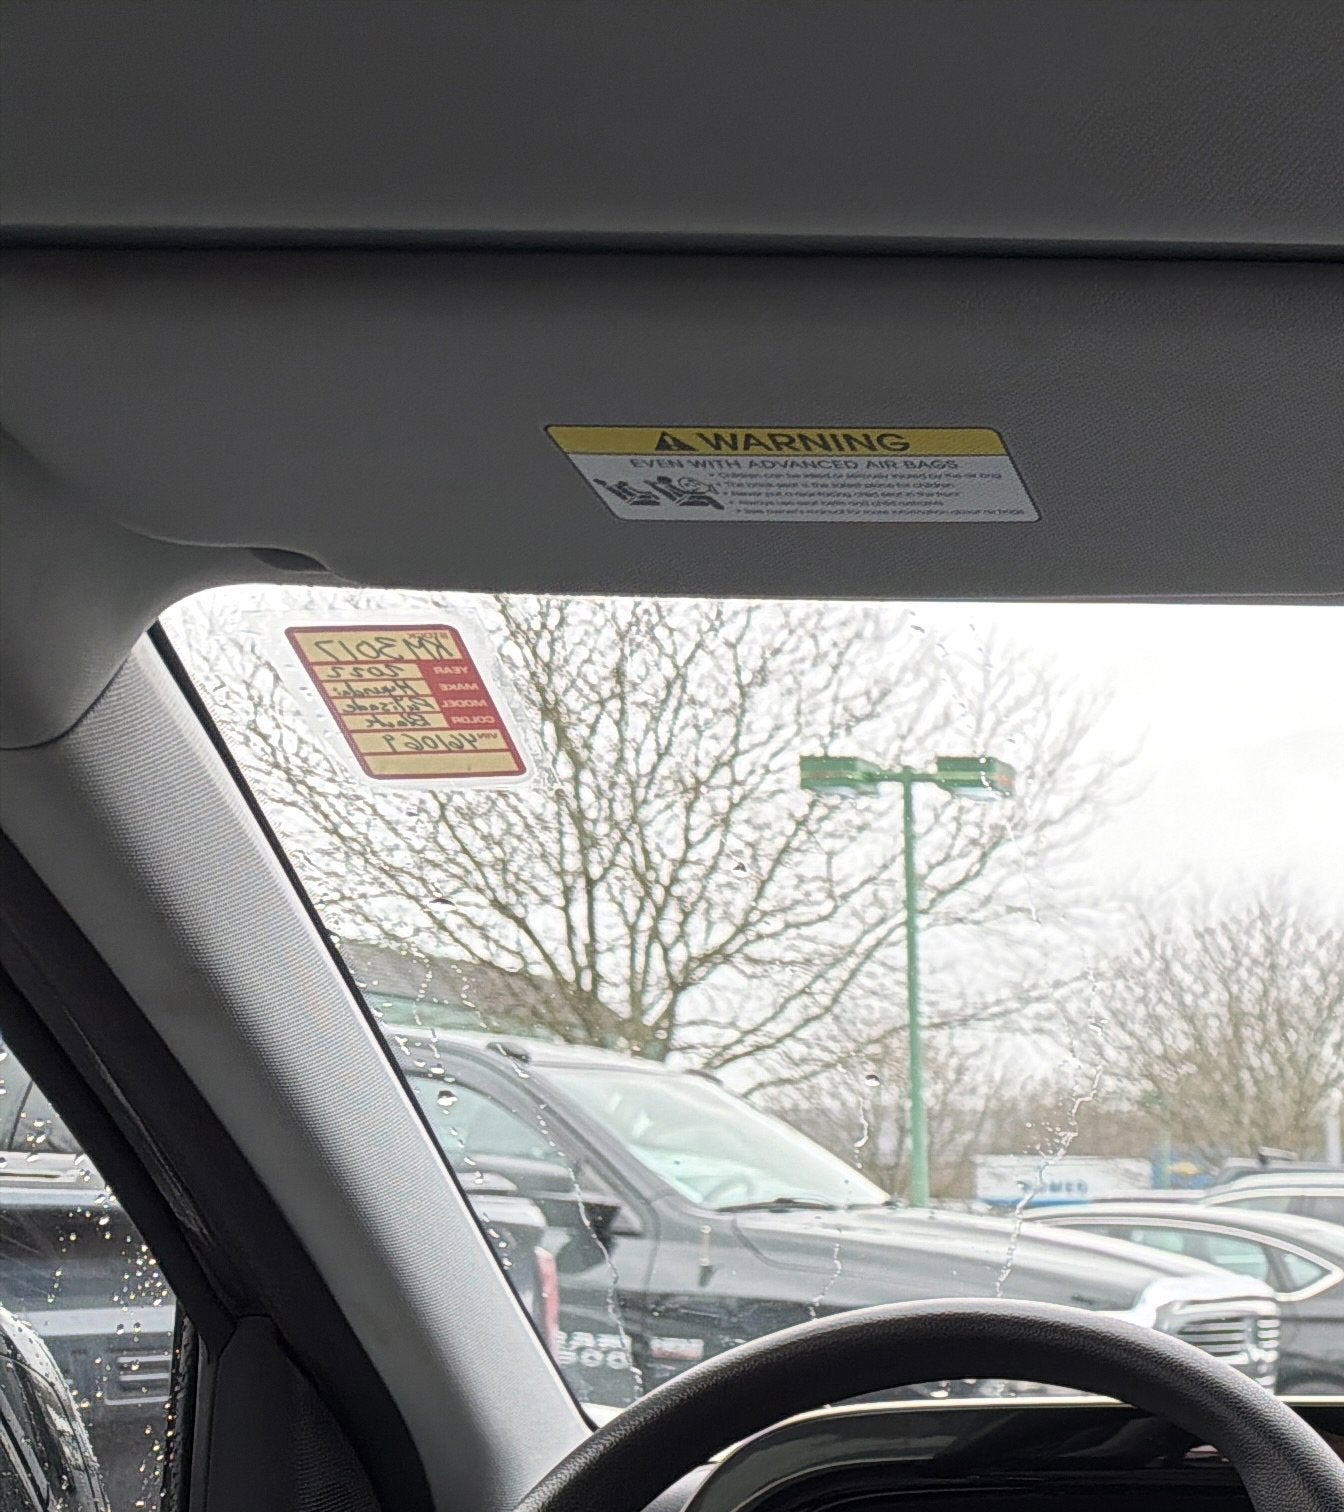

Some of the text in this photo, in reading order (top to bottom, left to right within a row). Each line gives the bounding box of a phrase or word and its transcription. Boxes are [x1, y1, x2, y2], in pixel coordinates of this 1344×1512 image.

[700, 432, 910, 452] WARNING
[630, 458, 958, 470] EVEN WITH ADVANCED AIR BAGS
